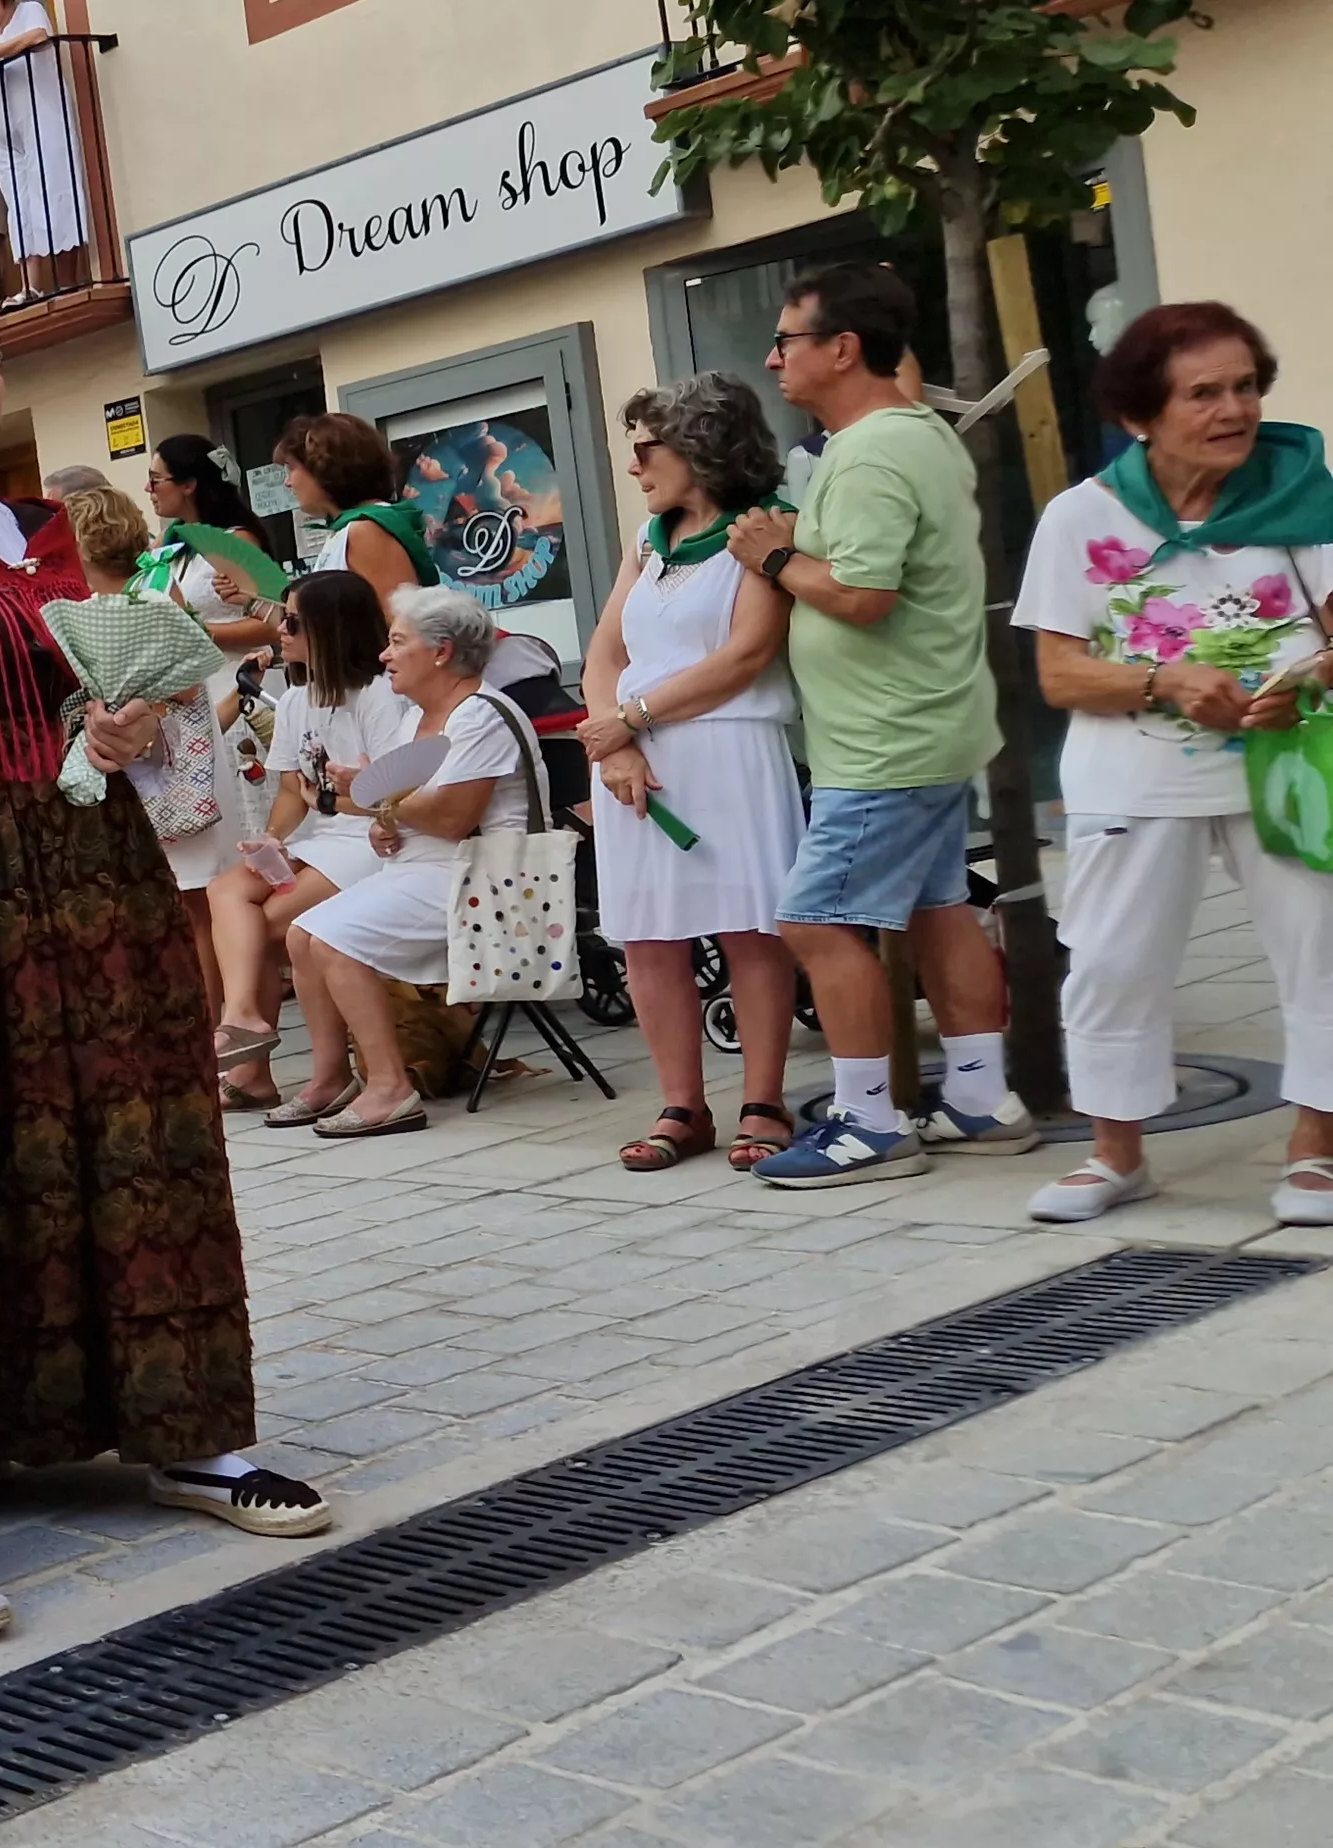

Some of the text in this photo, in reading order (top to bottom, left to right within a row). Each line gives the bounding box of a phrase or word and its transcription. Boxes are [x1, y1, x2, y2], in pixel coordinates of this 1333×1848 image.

[280, 186, 478, 276] Dream
[498, 121, 632, 227] shop
[504, 536, 555, 603] SHOP
